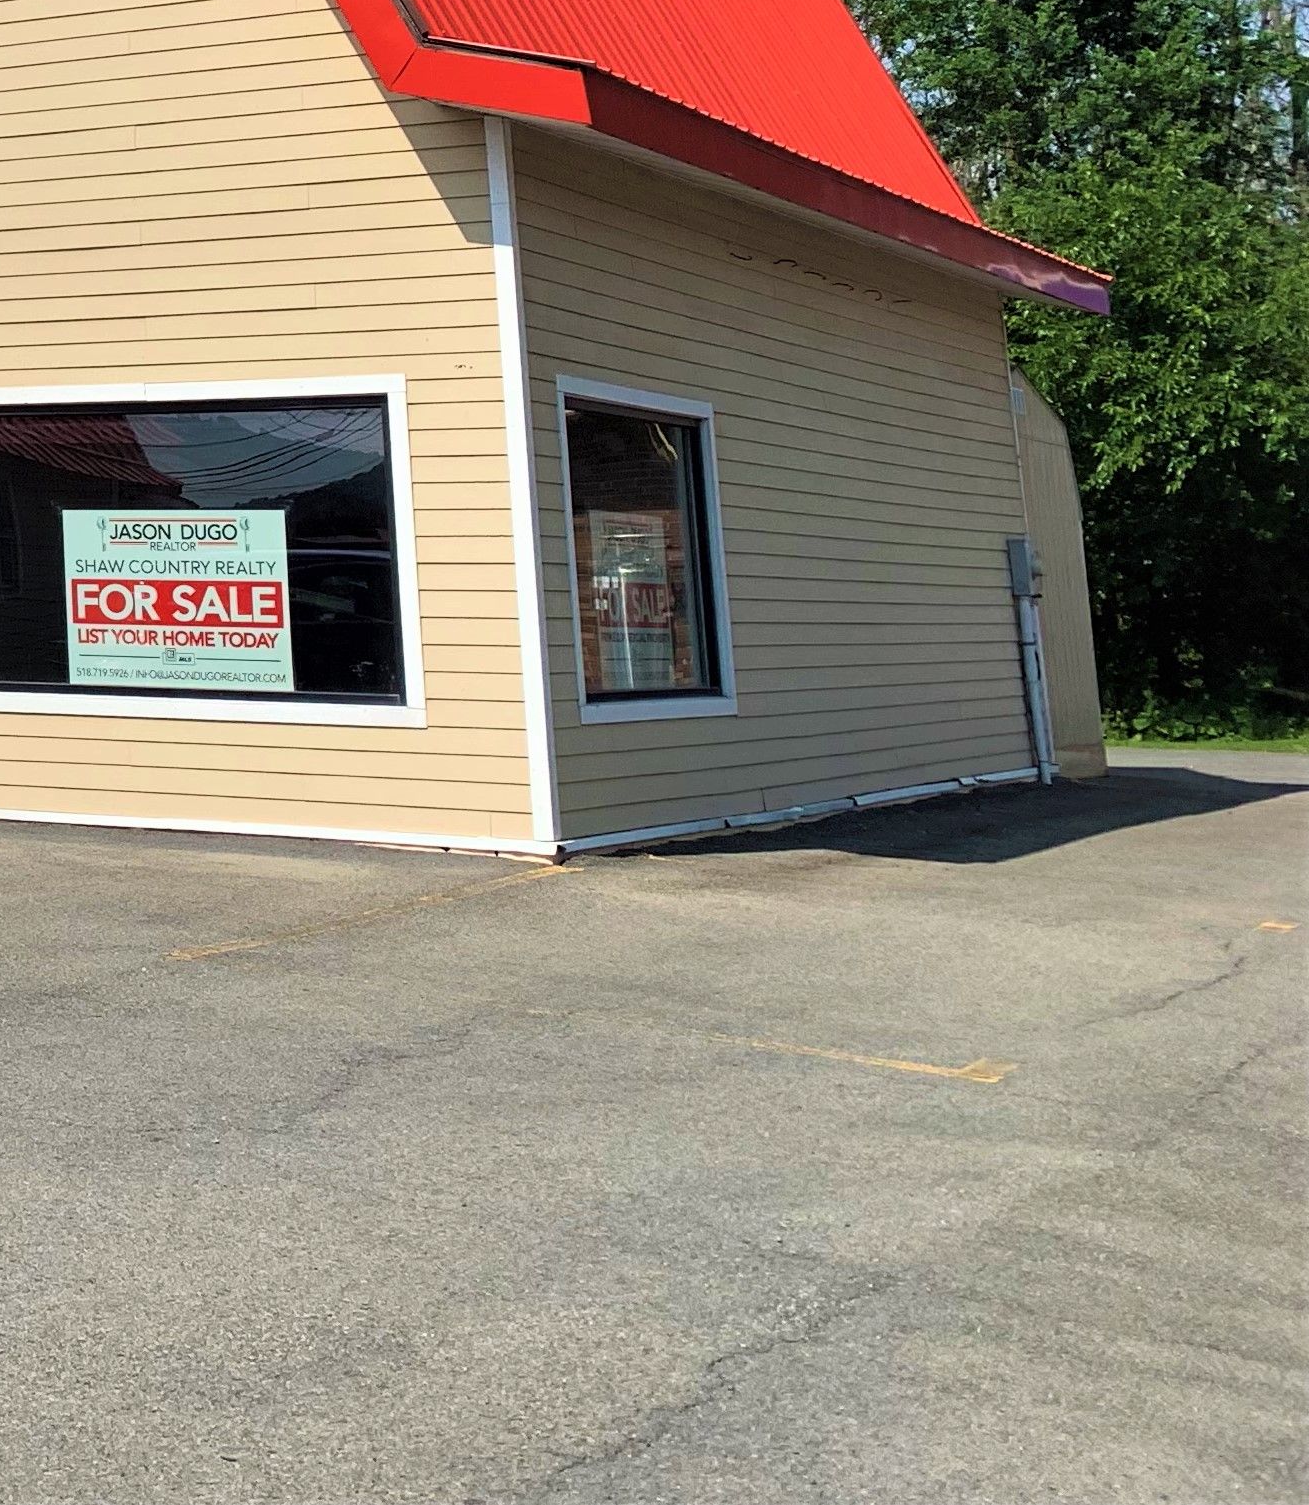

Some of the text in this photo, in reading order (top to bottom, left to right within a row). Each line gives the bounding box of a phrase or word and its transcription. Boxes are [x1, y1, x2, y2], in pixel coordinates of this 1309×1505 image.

[109, 523, 238, 541] JASON DUGO
[149, 542, 197, 552] REALTOR
[75, 559, 277, 576] SHAW COUNTRY REALTY
[76, 582, 280, 624] FOR SALE
[77, 628, 279, 649] LIST YOUR HOME TODAY
[76, 666, 129, 677] 518.719.5926
